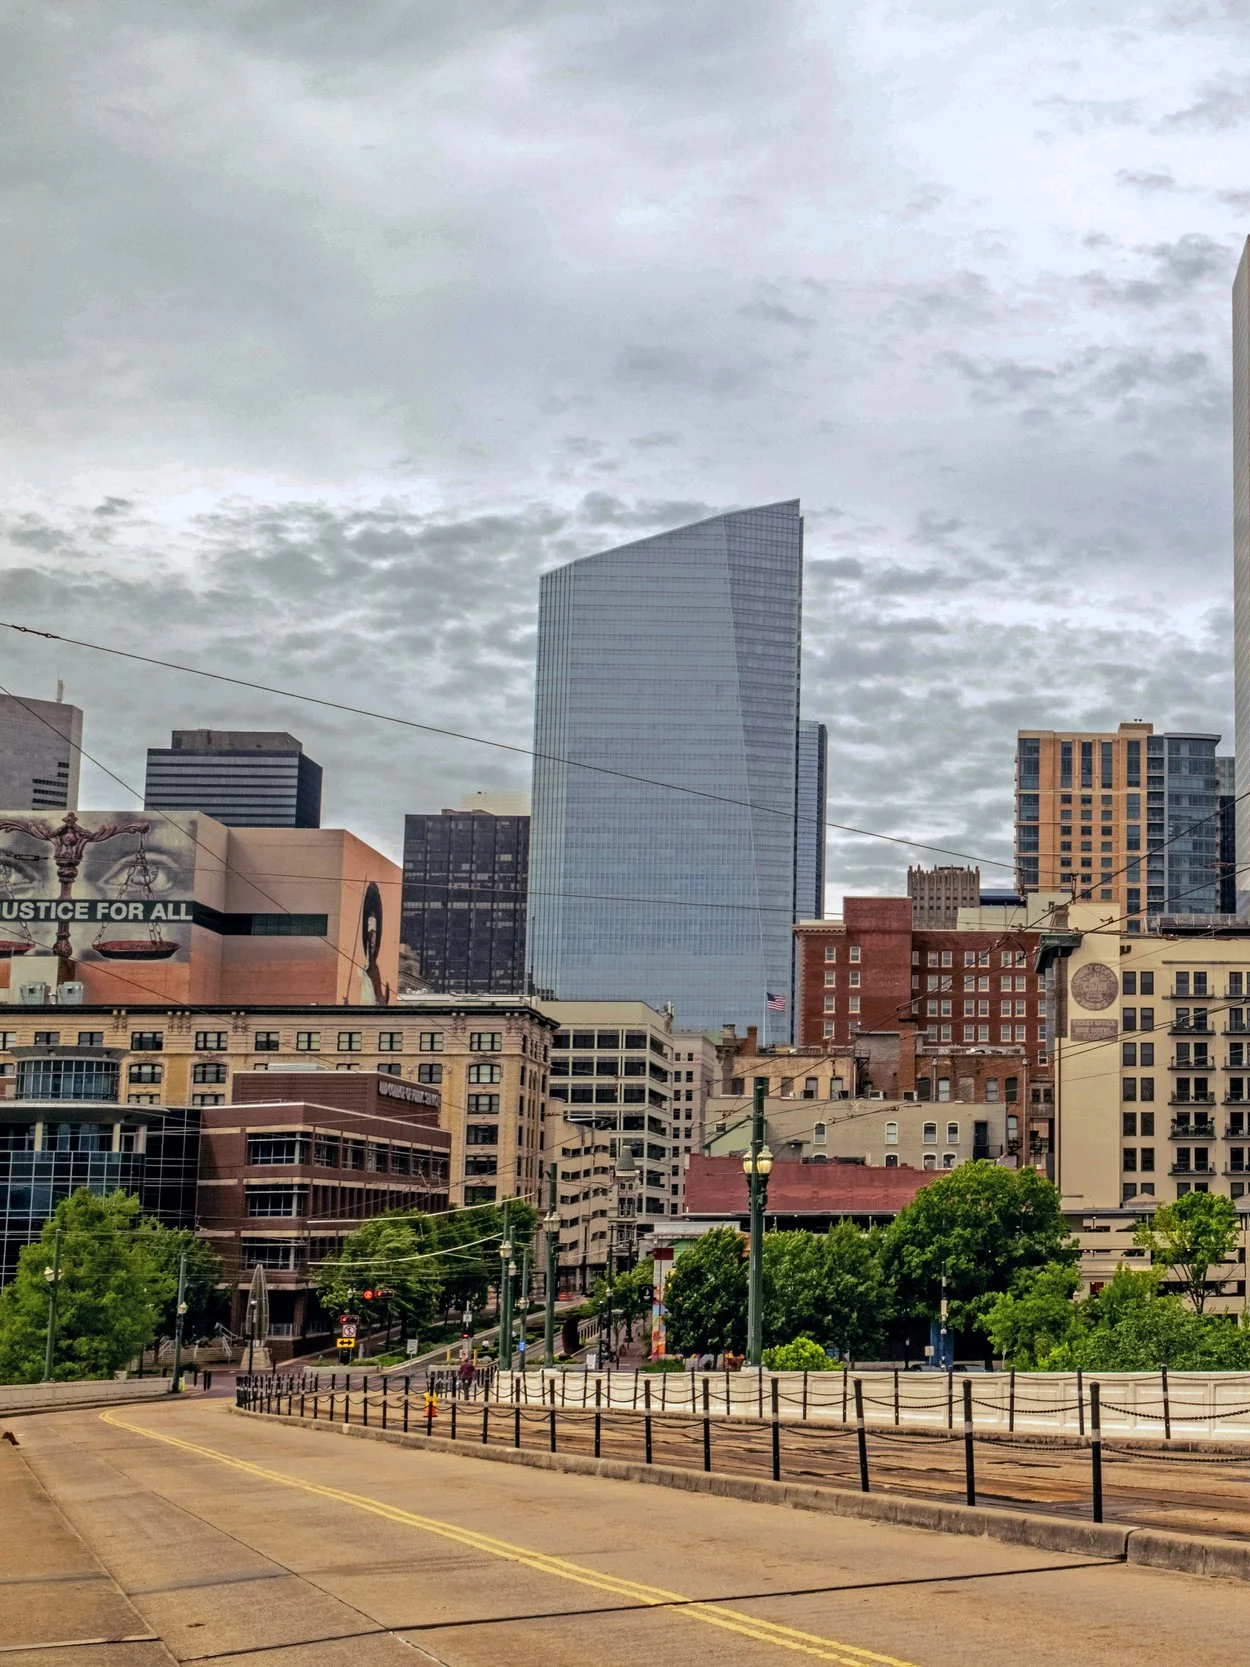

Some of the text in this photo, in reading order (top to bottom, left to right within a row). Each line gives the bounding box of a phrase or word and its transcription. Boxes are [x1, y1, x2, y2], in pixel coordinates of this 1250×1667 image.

[0, 902, 193, 921] USTICE FOR ALL
